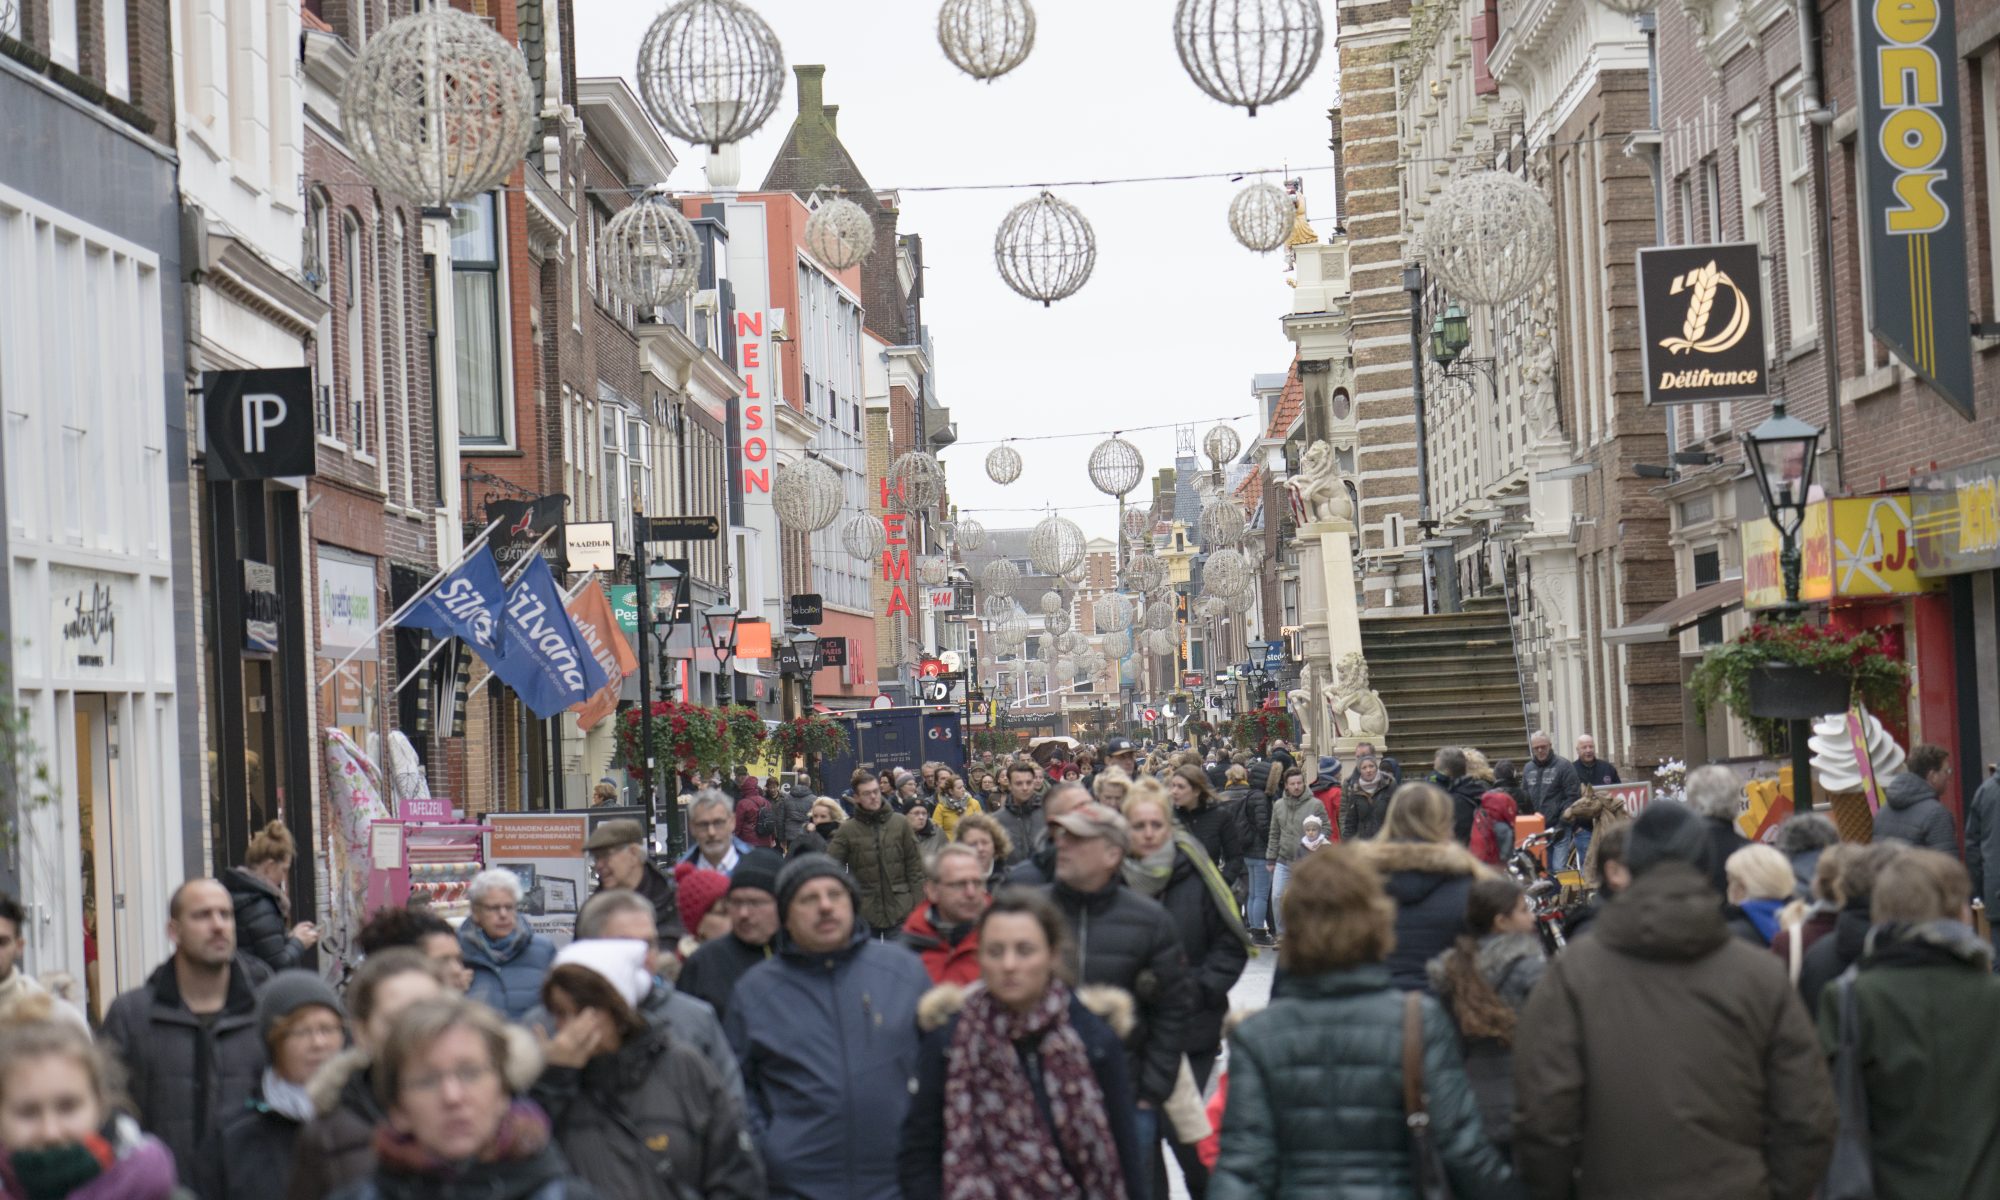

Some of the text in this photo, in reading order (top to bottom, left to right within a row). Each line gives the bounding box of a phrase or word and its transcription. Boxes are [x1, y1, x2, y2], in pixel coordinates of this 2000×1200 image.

[737, 311, 770, 494] NELSON
[1658, 368, 1758, 390] Délifrance
[880, 476, 912, 617] HEMA
[408, 801, 444, 816] TAFELZEIL
